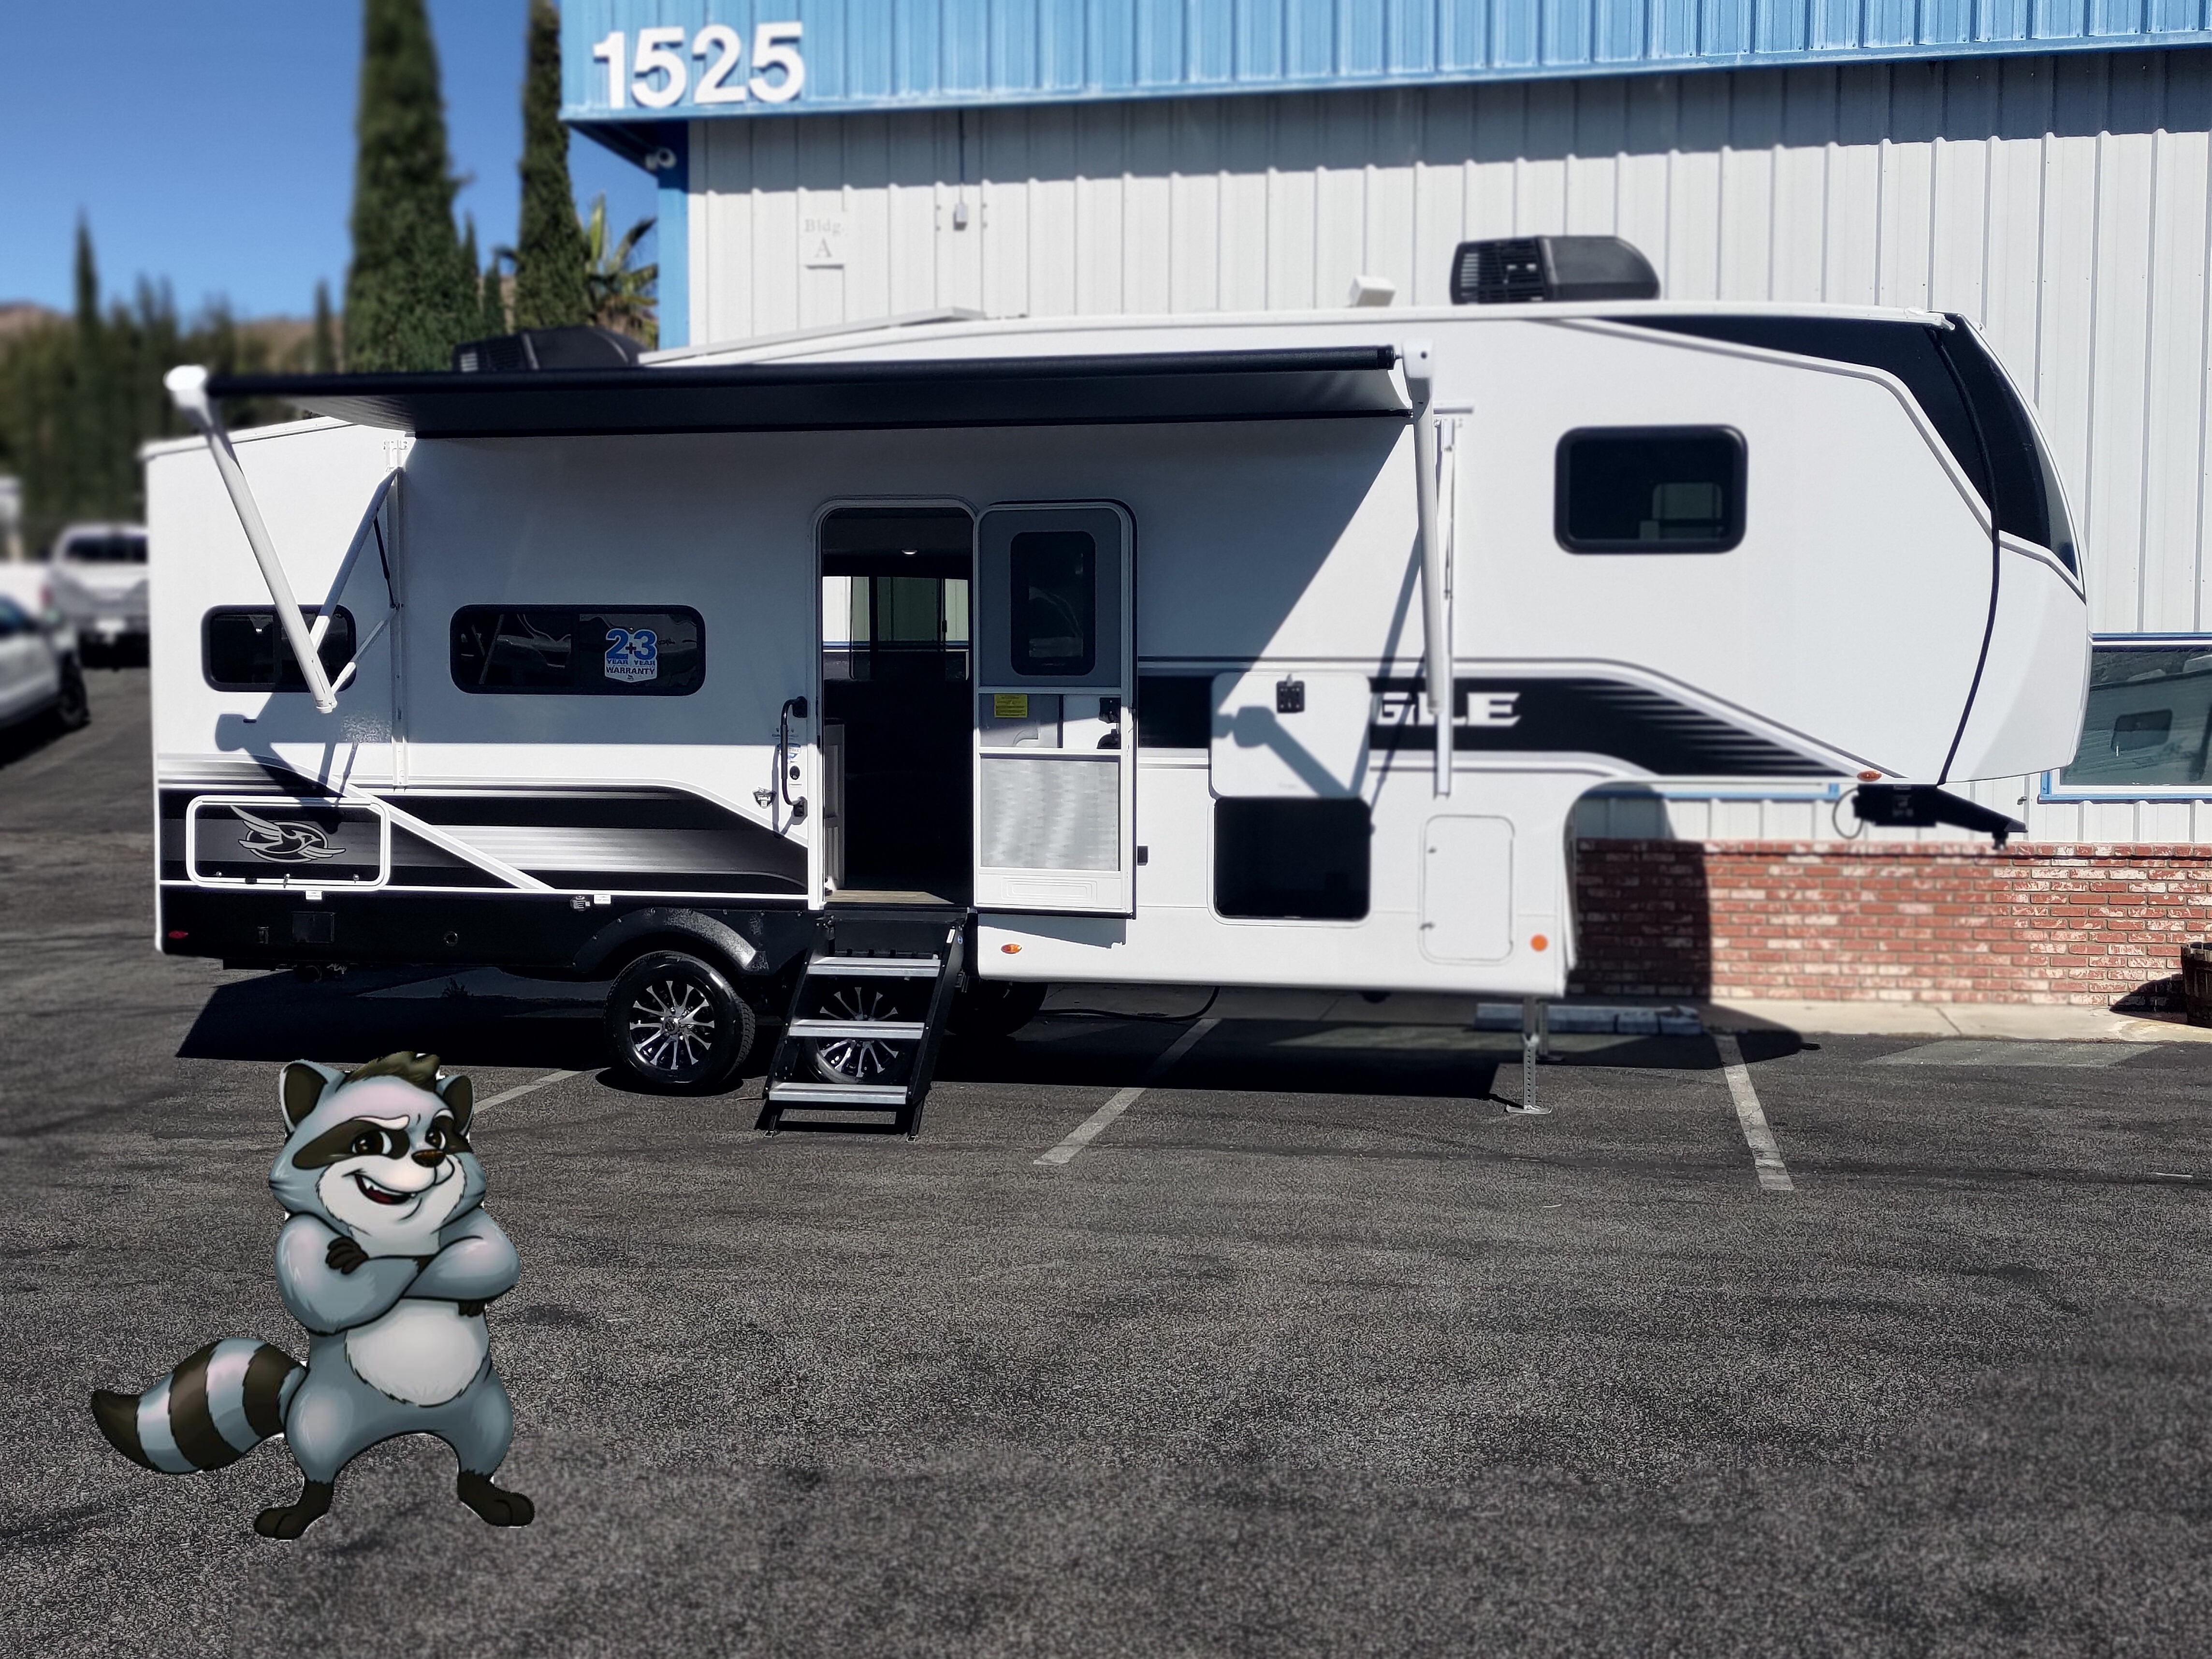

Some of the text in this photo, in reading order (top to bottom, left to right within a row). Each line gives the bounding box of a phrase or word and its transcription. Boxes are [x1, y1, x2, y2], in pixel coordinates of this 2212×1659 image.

[593, 22, 805, 109] 1525
[814, 237, 832, 258] A
[606, 666, 655, 675] WARRANTY
